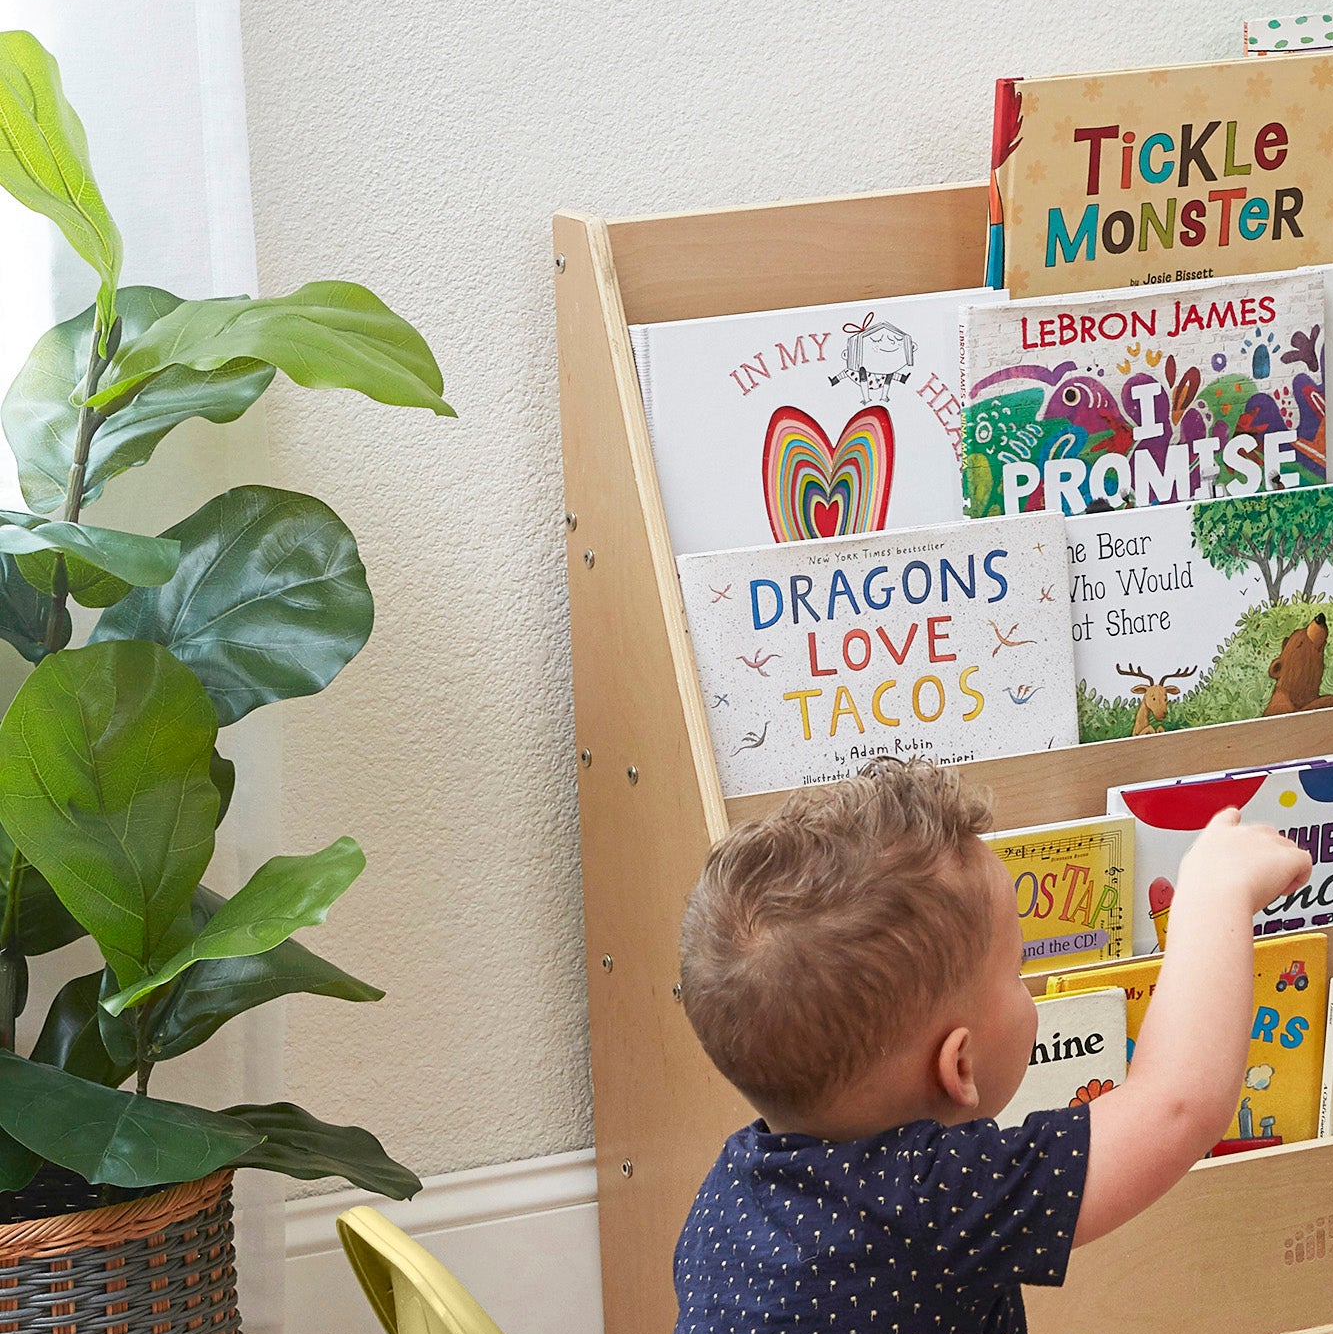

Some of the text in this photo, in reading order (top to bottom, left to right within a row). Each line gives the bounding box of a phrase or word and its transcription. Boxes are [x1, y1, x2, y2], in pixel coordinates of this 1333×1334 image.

[1130, 267, 1215, 286] by Josie Bissett
[1168, 295, 1277, 338] JAMES
[729, 332, 962, 473] IN MY HEA
[1130, 383, 1164, 441] I
[1002, 430, 1300, 516] PROMISE
[896, 542, 945, 557] bestseller
[1097, 532, 1152, 560] Bear
[749, 549, 1009, 630] DRAGONS
[1116, 561, 1194, 596] Would
[1072, 609, 1171, 643] ot Share
[807, 615, 957, 678] LOVE
[783, 665, 986, 741] TACOS
[834, 738, 934, 765] by Adam Rubin
[803, 767, 850, 785] illustrated
[1049, 939, 1070, 953] the
[1074, 933, 1098, 949] CD!
[1125, 986, 1144, 1000] My
[1028, 1032, 1104, 1065] hine
